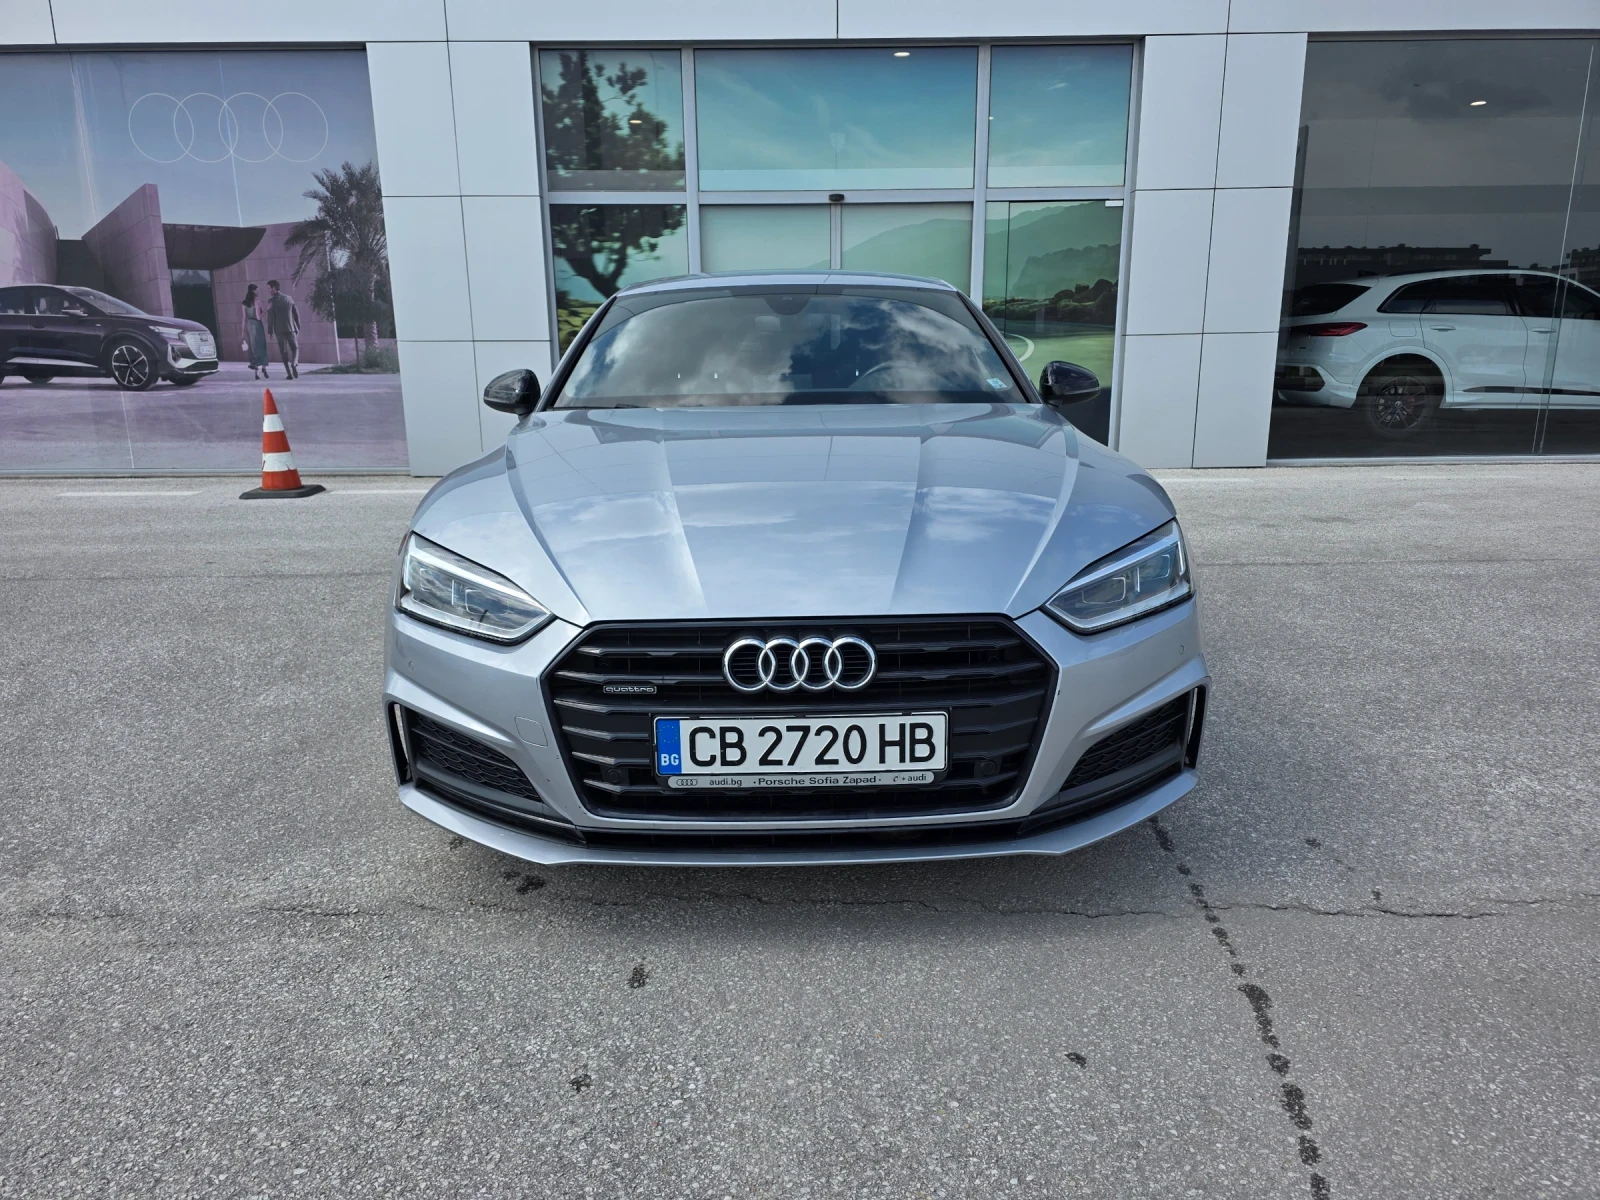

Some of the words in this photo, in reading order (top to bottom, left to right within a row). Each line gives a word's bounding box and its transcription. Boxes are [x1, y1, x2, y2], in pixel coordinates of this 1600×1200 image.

[689, 726, 747, 767] CB
[758, 724, 867, 766] 2720
[878, 722, 936, 764] HB
[660, 753, 679, 766] BG
[709, 777, 742, 788] audi.bg
[758, 777, 805, 786] Porsche
[809, 776, 839, 785] Sofia
[843, 775, 877, 786] Zapad
